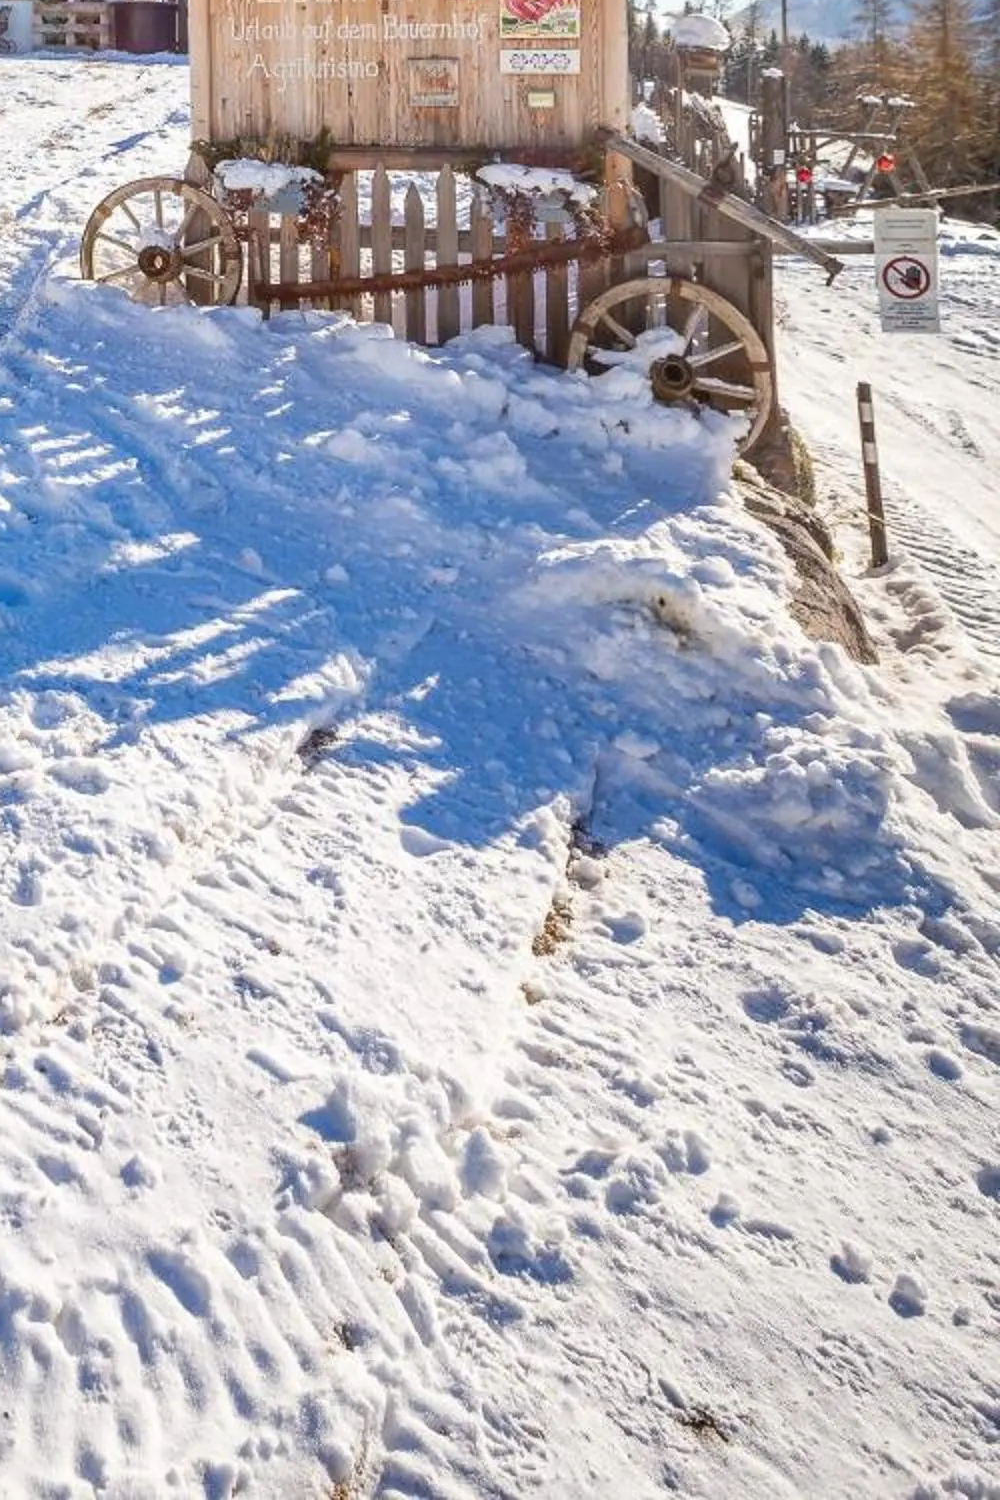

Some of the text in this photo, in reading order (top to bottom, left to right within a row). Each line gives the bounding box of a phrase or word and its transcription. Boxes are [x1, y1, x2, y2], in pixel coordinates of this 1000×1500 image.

[229, 11, 489, 46] Urlaub auf dem Bauernhof
